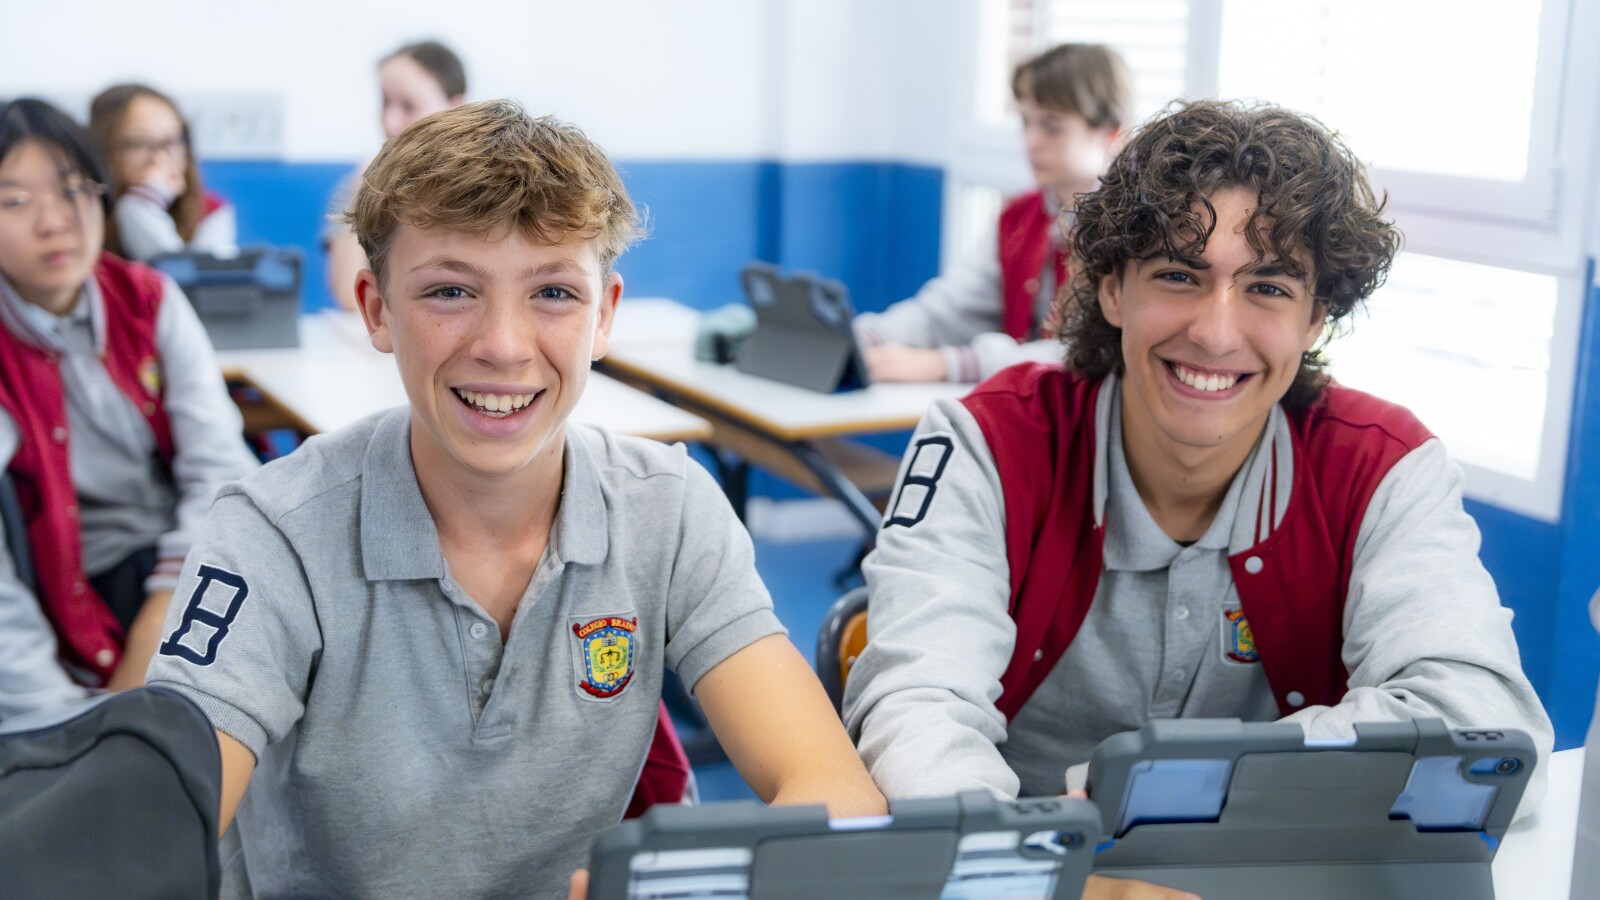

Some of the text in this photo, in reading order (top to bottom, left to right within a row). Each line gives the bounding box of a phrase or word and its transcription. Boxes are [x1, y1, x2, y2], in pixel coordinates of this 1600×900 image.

[882, 436, 954, 528] B
[158, 563, 249, 666] B
[579, 619, 607, 637] COLEGIO
